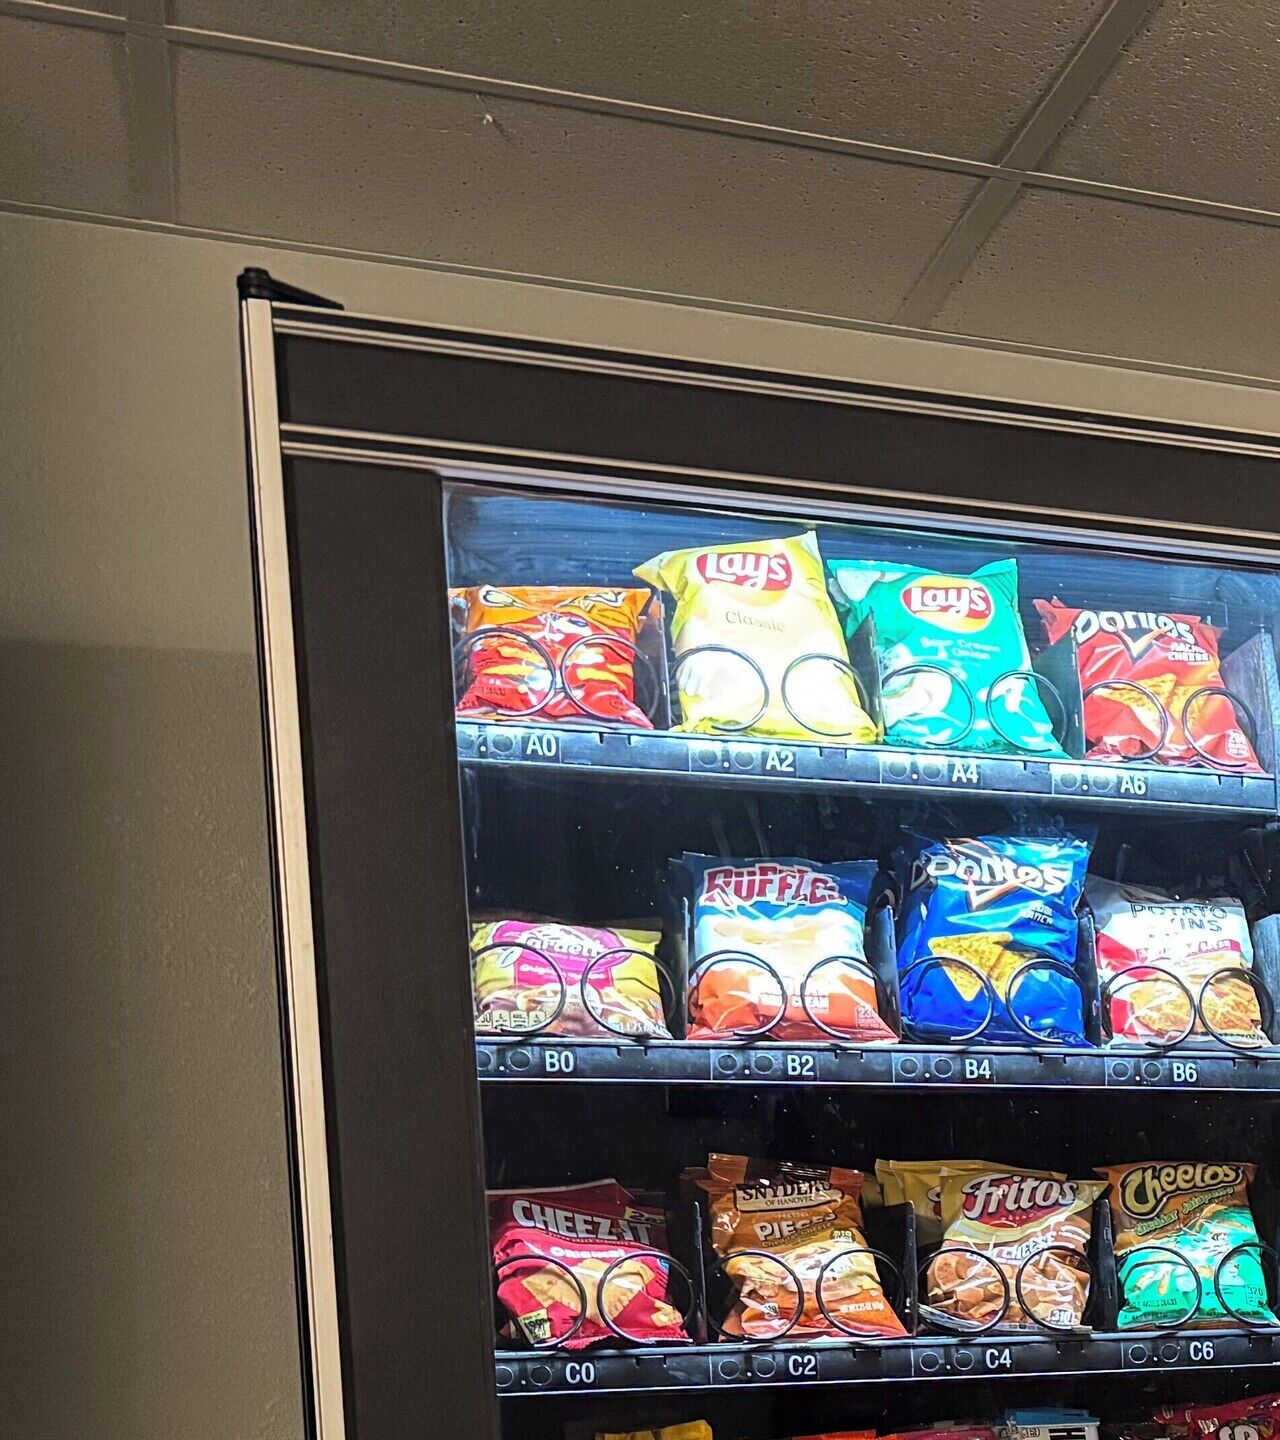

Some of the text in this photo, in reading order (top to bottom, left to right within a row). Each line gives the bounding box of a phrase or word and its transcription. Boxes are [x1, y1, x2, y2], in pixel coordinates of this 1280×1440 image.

[526, 733, 556, 756] A0
[766, 751, 794, 772] A2
[952, 764, 980, 784] A4
[1121, 774, 1147, 796] A6
[1130, 903, 1228, 919] POTATO
[545, 1051, 575, 1073] B0
[787, 1055, 814, 1077] B2
[965, 1059, 991, 1080] B4
[1173, 1063, 1198, 1083] B6
[961, 1173, 1078, 1220] Fritos
[1124, 1164, 1236, 1213] Cheetos
[985, 1348, 1011, 1369] C4
[1190, 1342, 1215, 1362] C6
[566, 1362, 595, 1385] C0
[788, 1354, 817, 1377] C2
